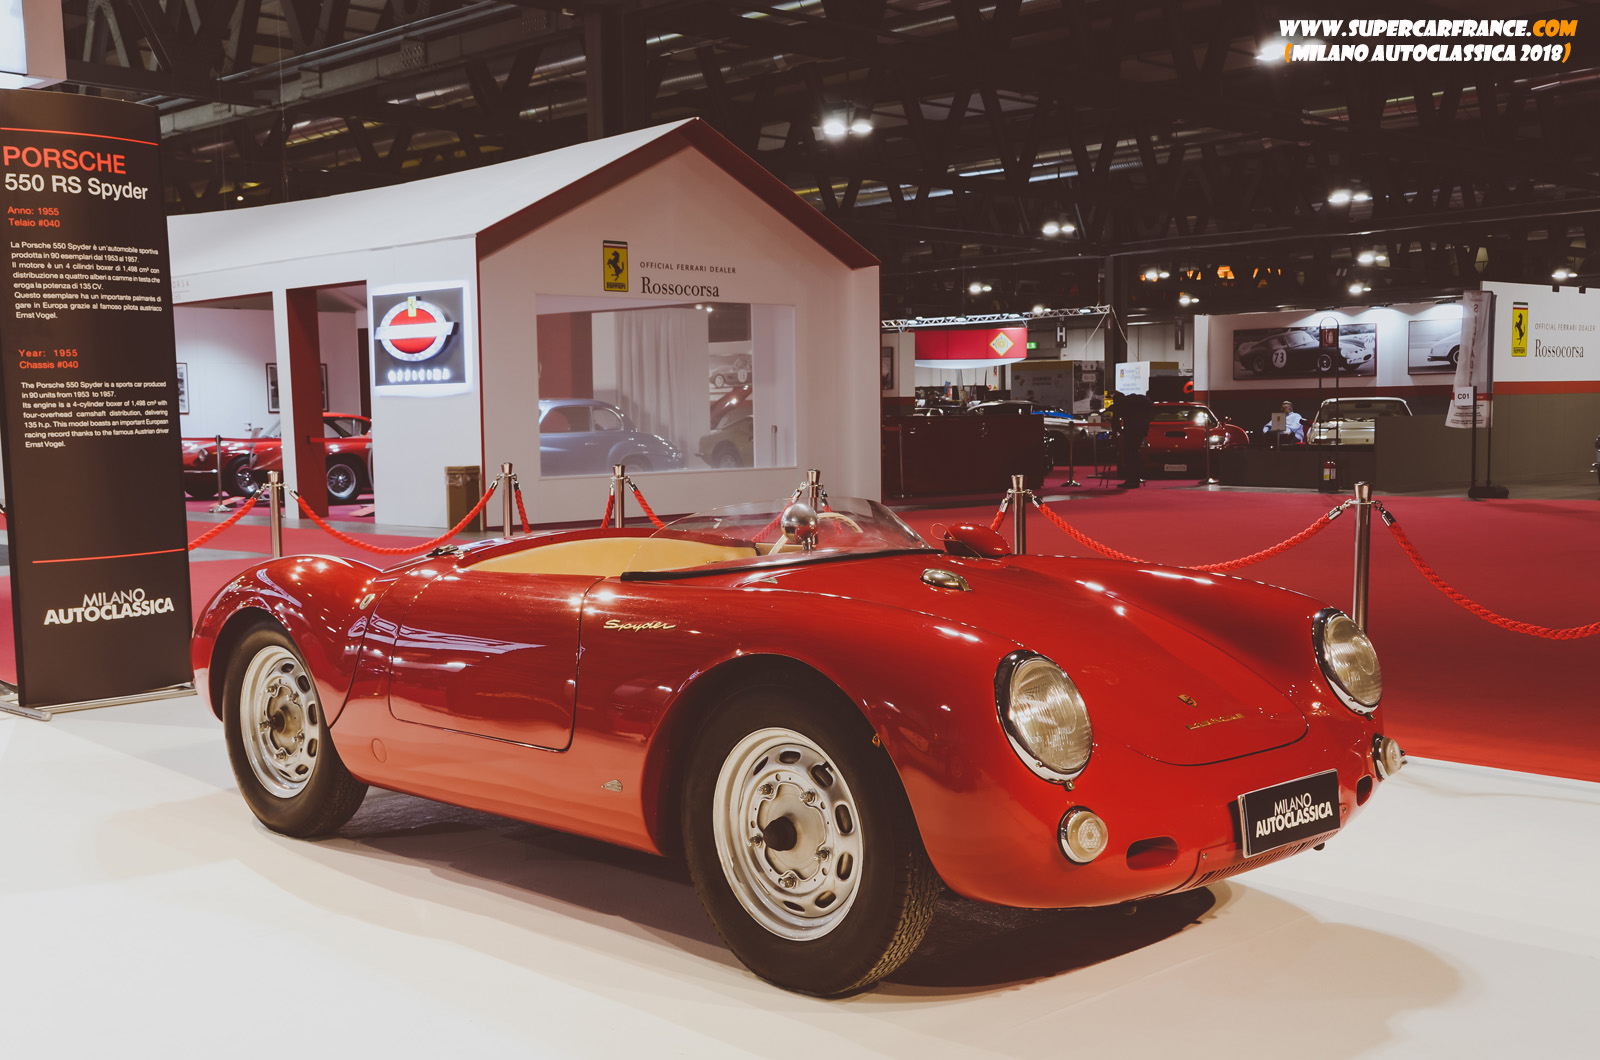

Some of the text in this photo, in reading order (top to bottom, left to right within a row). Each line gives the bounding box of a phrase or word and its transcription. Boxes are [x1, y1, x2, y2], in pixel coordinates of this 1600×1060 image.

[2, 145, 127, 175] PORSCHE
[4, 172, 149, 201] 550 RS Spyder
[7, 205, 60, 216] Anno: 1955
[8, 217, 61, 228] Telaio #040
[21, 241, 51, 249] Porsche
[67, 242, 92, 251] Spyder
[60, 253, 93, 261] esemplari
[639, 261, 736, 274] OFFICIAL FERRARI DEALER
[13, 282, 35, 290] eroga
[42, 282, 71, 290] potenza
[79, 282, 91, 290] 135
[640, 276, 720, 298] Rossocorsa
[14, 291, 41, 299] Questo
[42, 292, 79, 300] esemplare
[14, 302, 32, 310] gare
[42, 301, 68, 310] Europa
[69, 303, 90, 311] grazie
[15, 311, 58, 320] Ernst Vogel.
[1534, 323, 1596, 332] OFFICIAL FERRARI DEALER
[1056, 326, 1066, 342] H
[18, 348, 79, 358] Year: 1955
[1534, 338, 1584, 358] Rossocorsa
[1274, 352, 1285, 363] 73
[19, 360, 79, 369] Chassis #040
[20, 381, 35, 389] The
[35, 381, 65, 389] Porsche
[80, 381, 103, 389] Spyder
[21, 391, 29, 399] in
[28, 391, 38, 399] 90
[38, 391, 56, 399] units
[22, 401, 32, 409] Its
[33, 402, 57, 410] engine
[72, 401, 105, 409] 4-cylinder
[22, 411, 73, 419] four-overhead
[144, 409, 168, 417] delivering
[24, 421, 37, 429] 135
[38, 421, 52, 429] h.p.
[52, 420, 68, 428] This
[119, 419, 146, 427] important
[145, 418, 169, 426] European
[24, 431, 47, 439] racing
[47, 430, 70, 438] record
[112, 428, 134, 436] famous
[43, 440, 66, 449] Vogel.
[82, 587, 146, 609] MILANO
[43, 597, 175, 626] AUTOCLASSICA
[603, 619, 677, 633] Spyder
[1273, 792, 1312, 816] MILANO
[1255, 801, 1333, 838] AUTOCLASSICA
